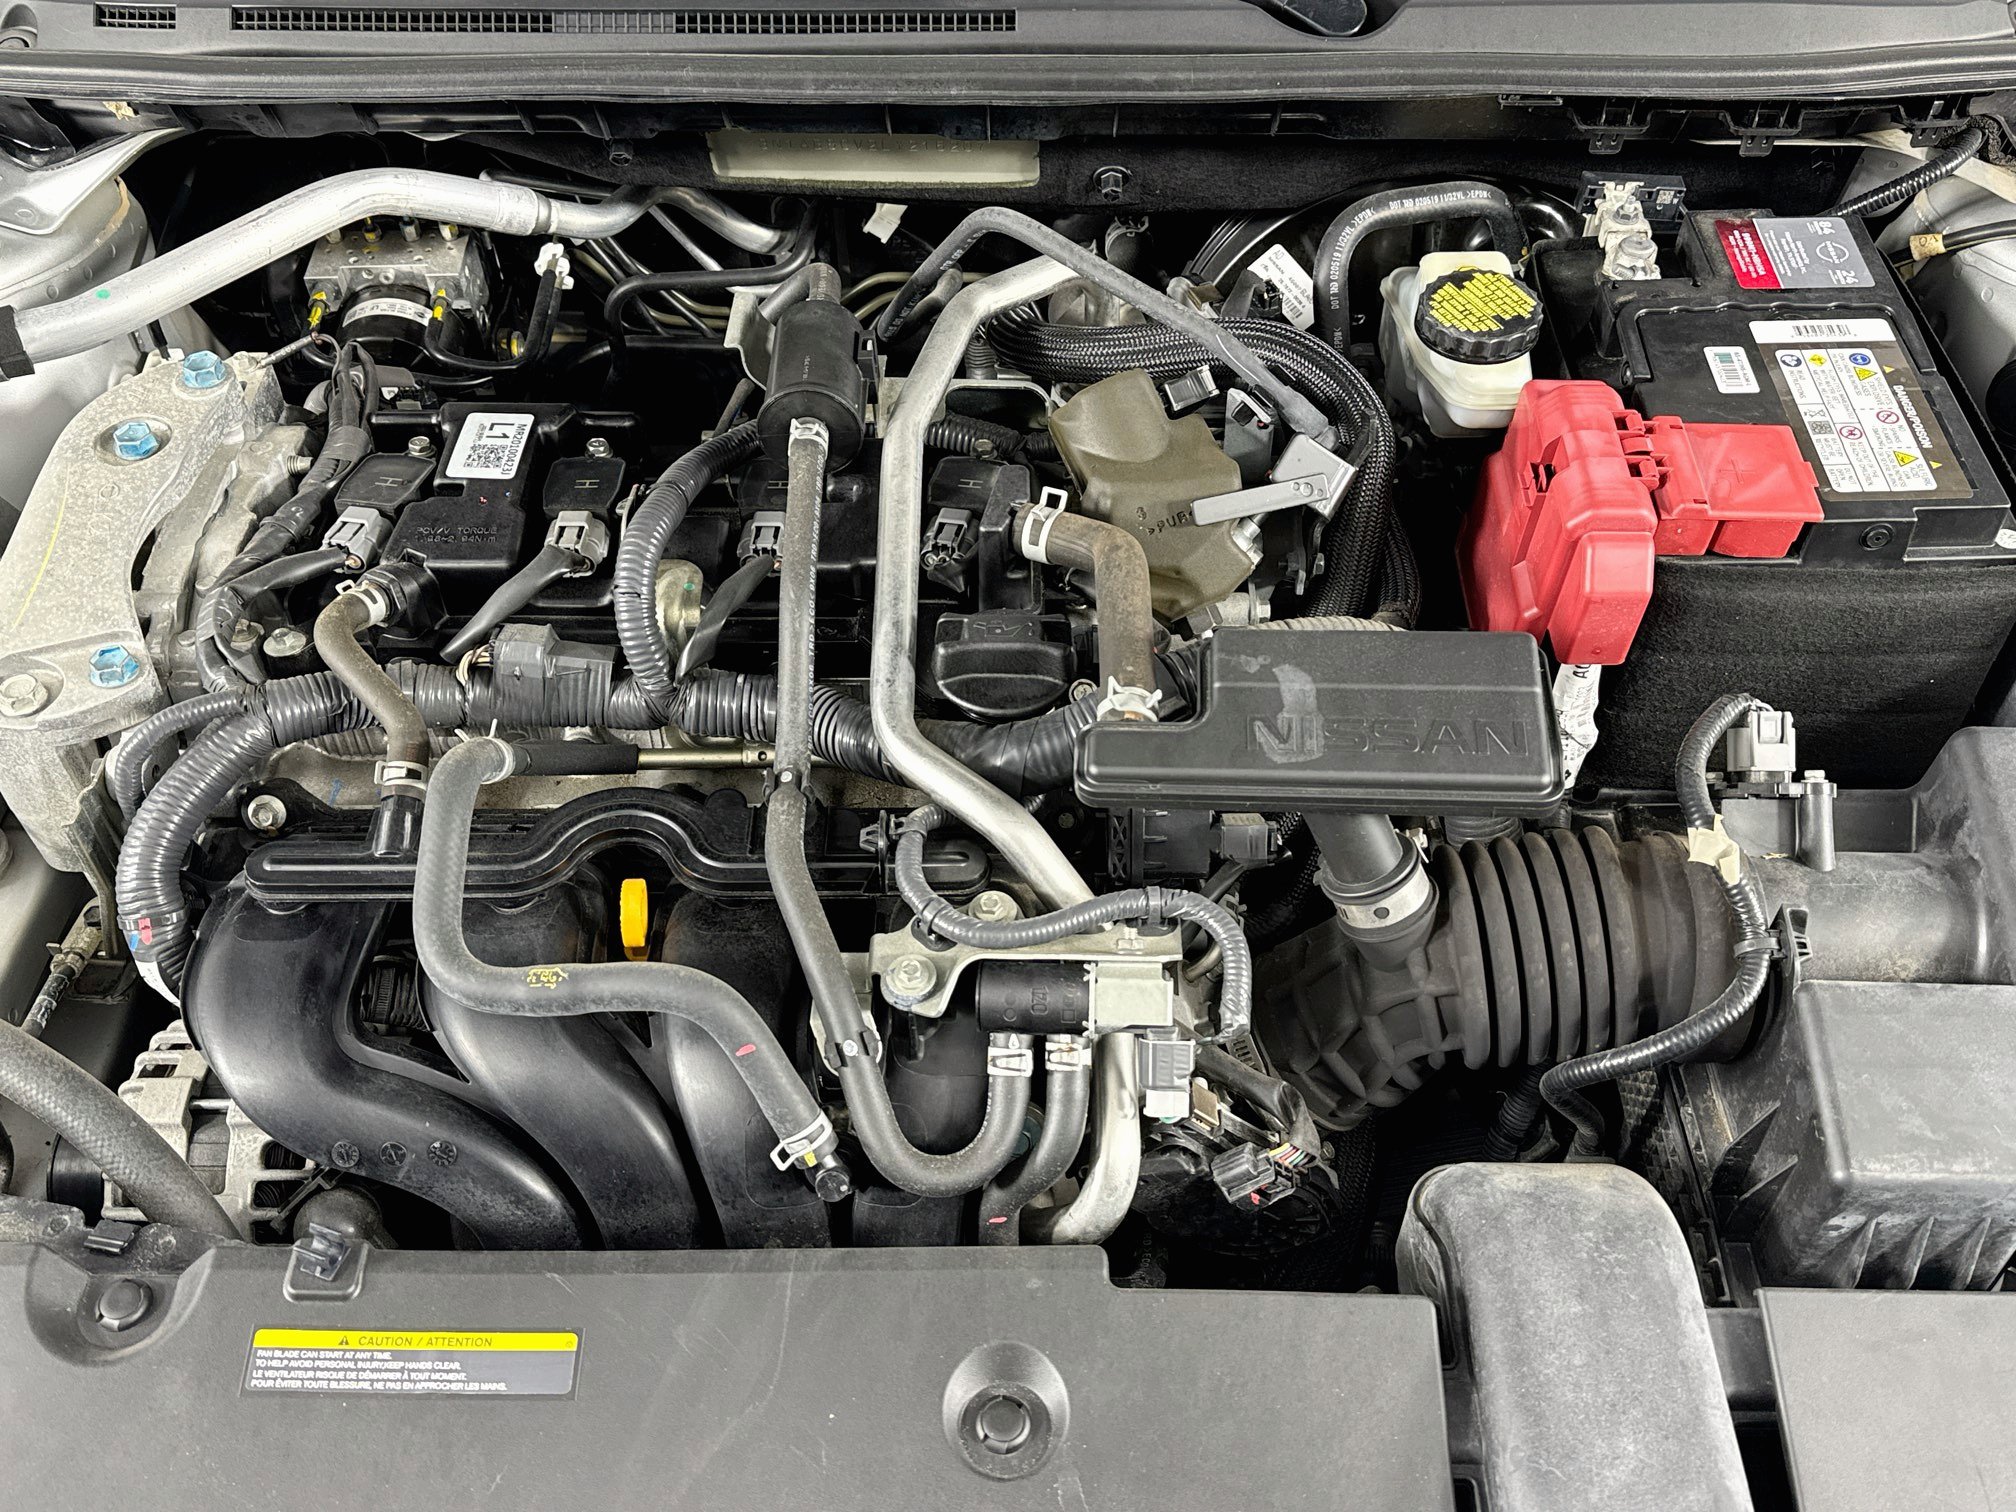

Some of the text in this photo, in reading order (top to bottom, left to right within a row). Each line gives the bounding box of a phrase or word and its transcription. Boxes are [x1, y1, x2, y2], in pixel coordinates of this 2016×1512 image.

[1824, 240, 1840, 263] NISSAN
[1330, 252, 1342, 280] 020519
[1892, 384, 1933, 448] DANGER/POISON
[485, 422, 515, 438] L1
[417, 526, 497, 534] PCV/V TORQUE
[1246, 713, 1530, 757] NISSAN
[358, 1336, 413, 1346] CAUTION
[426, 1336, 493, 1347] ATTENTION
[257, 1350, 273, 1358] FAN
[274, 1350, 300, 1358] BLADE
[301, 1350, 318, 1359] CAN
[319, 1351, 343, 1359] START
[344, 1351, 355, 1359] AT
[355, 1351, 372, 1359] ANY
[255, 1359, 267, 1367] TO
[268, 1359, 289, 1367] HELP
[289, 1360, 313, 1368] AVOID
[314, 1360, 356, 1369] PERSONAL
[405, 1362, 433, 1370] HANDS
[252, 1369, 263, 1378] LE
[264, 1370, 315, 1379] VENTILATEUR
[315, 1371, 345, 1379] RISQUE
[346, 1371, 357, 1379] DE
[358, 1369, 402, 1380] DÉMARRER
[250, 1379, 274, 1388] POUR
[303, 1380, 329, 1388] TOUTE
[329, 1381, 372, 1390] BLESSURE,
[373, 1382, 385, 1390] NE
[386, 1382, 401, 1390] PAS
[403, 1382, 414, 1390] EN
[415, 1382, 464, 1390] APPROCHER
[465, 1382, 480, 1391] LES
